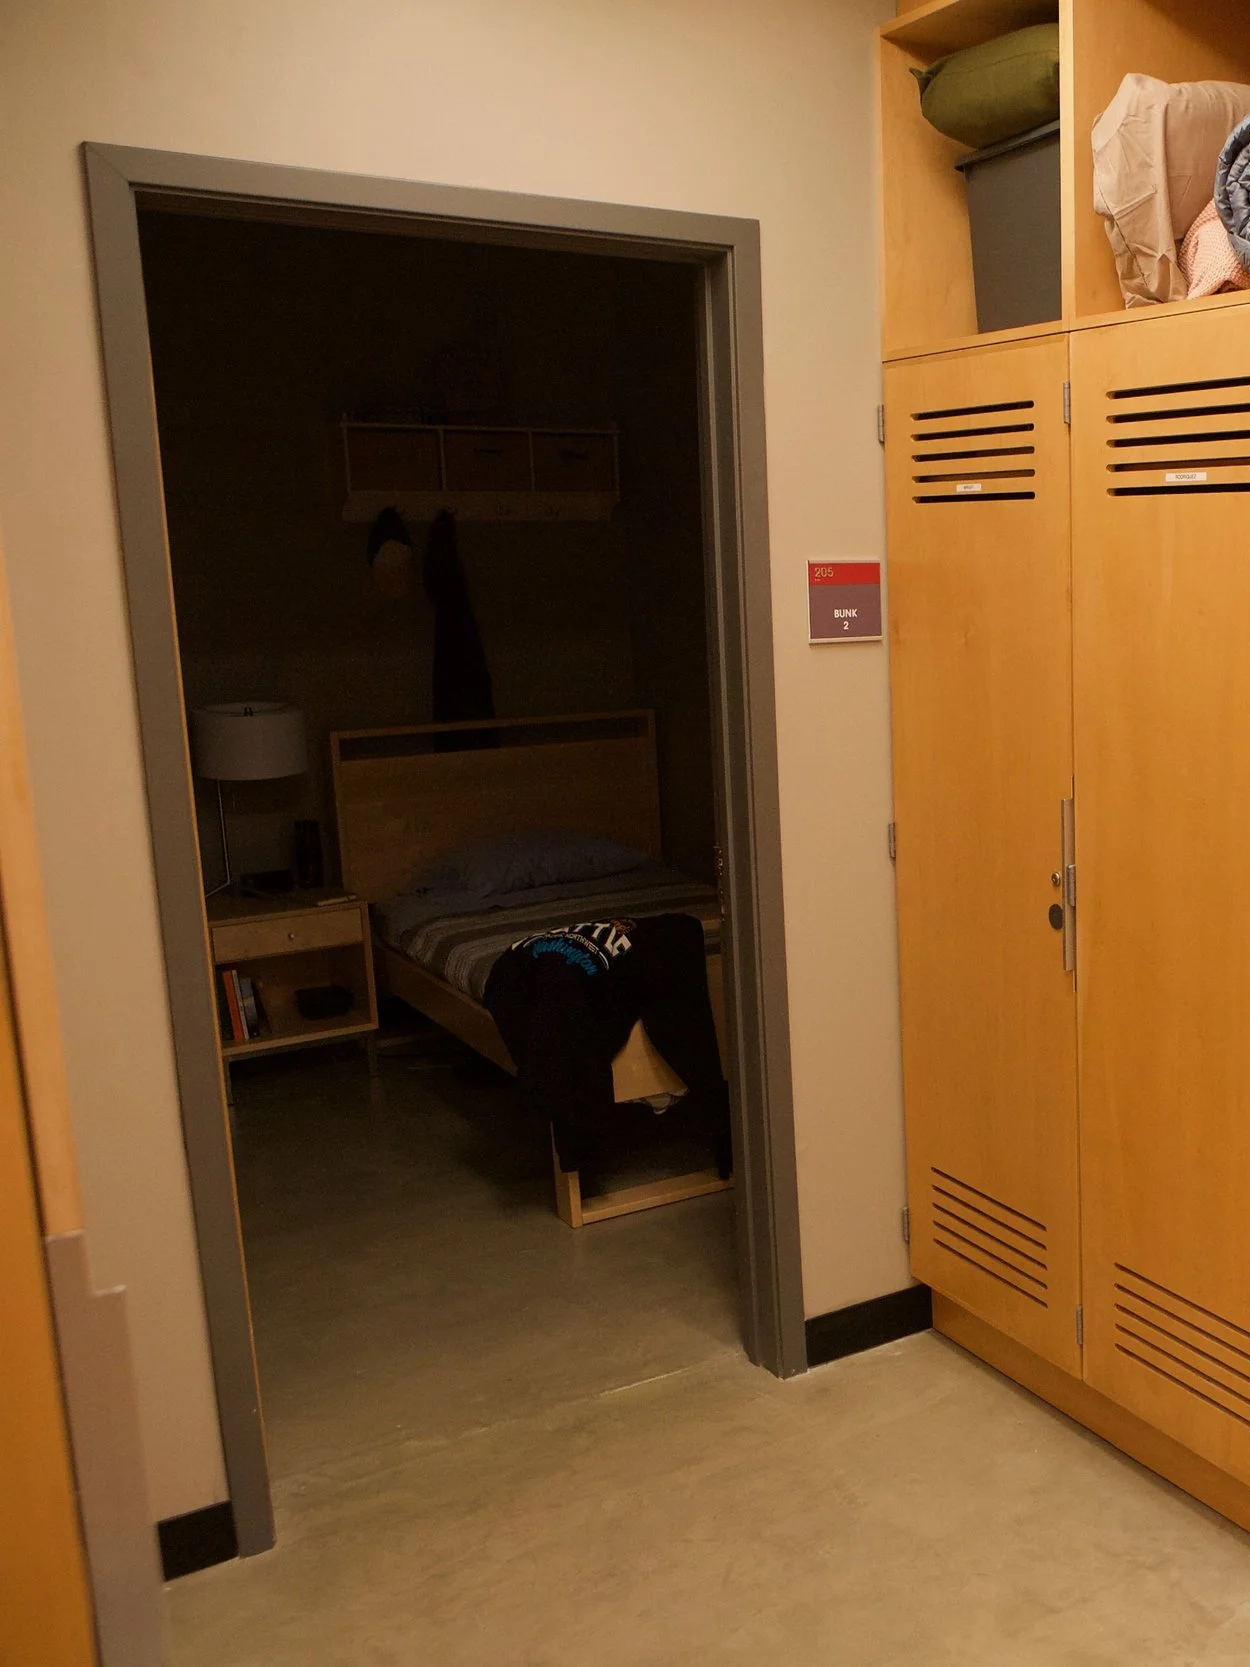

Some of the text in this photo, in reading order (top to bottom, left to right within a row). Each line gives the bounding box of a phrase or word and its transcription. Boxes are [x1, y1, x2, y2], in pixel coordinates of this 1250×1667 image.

[814, 567, 834, 578] 205
[834, 608, 858, 618] BUNK
[843, 621, 849, 630] 2
